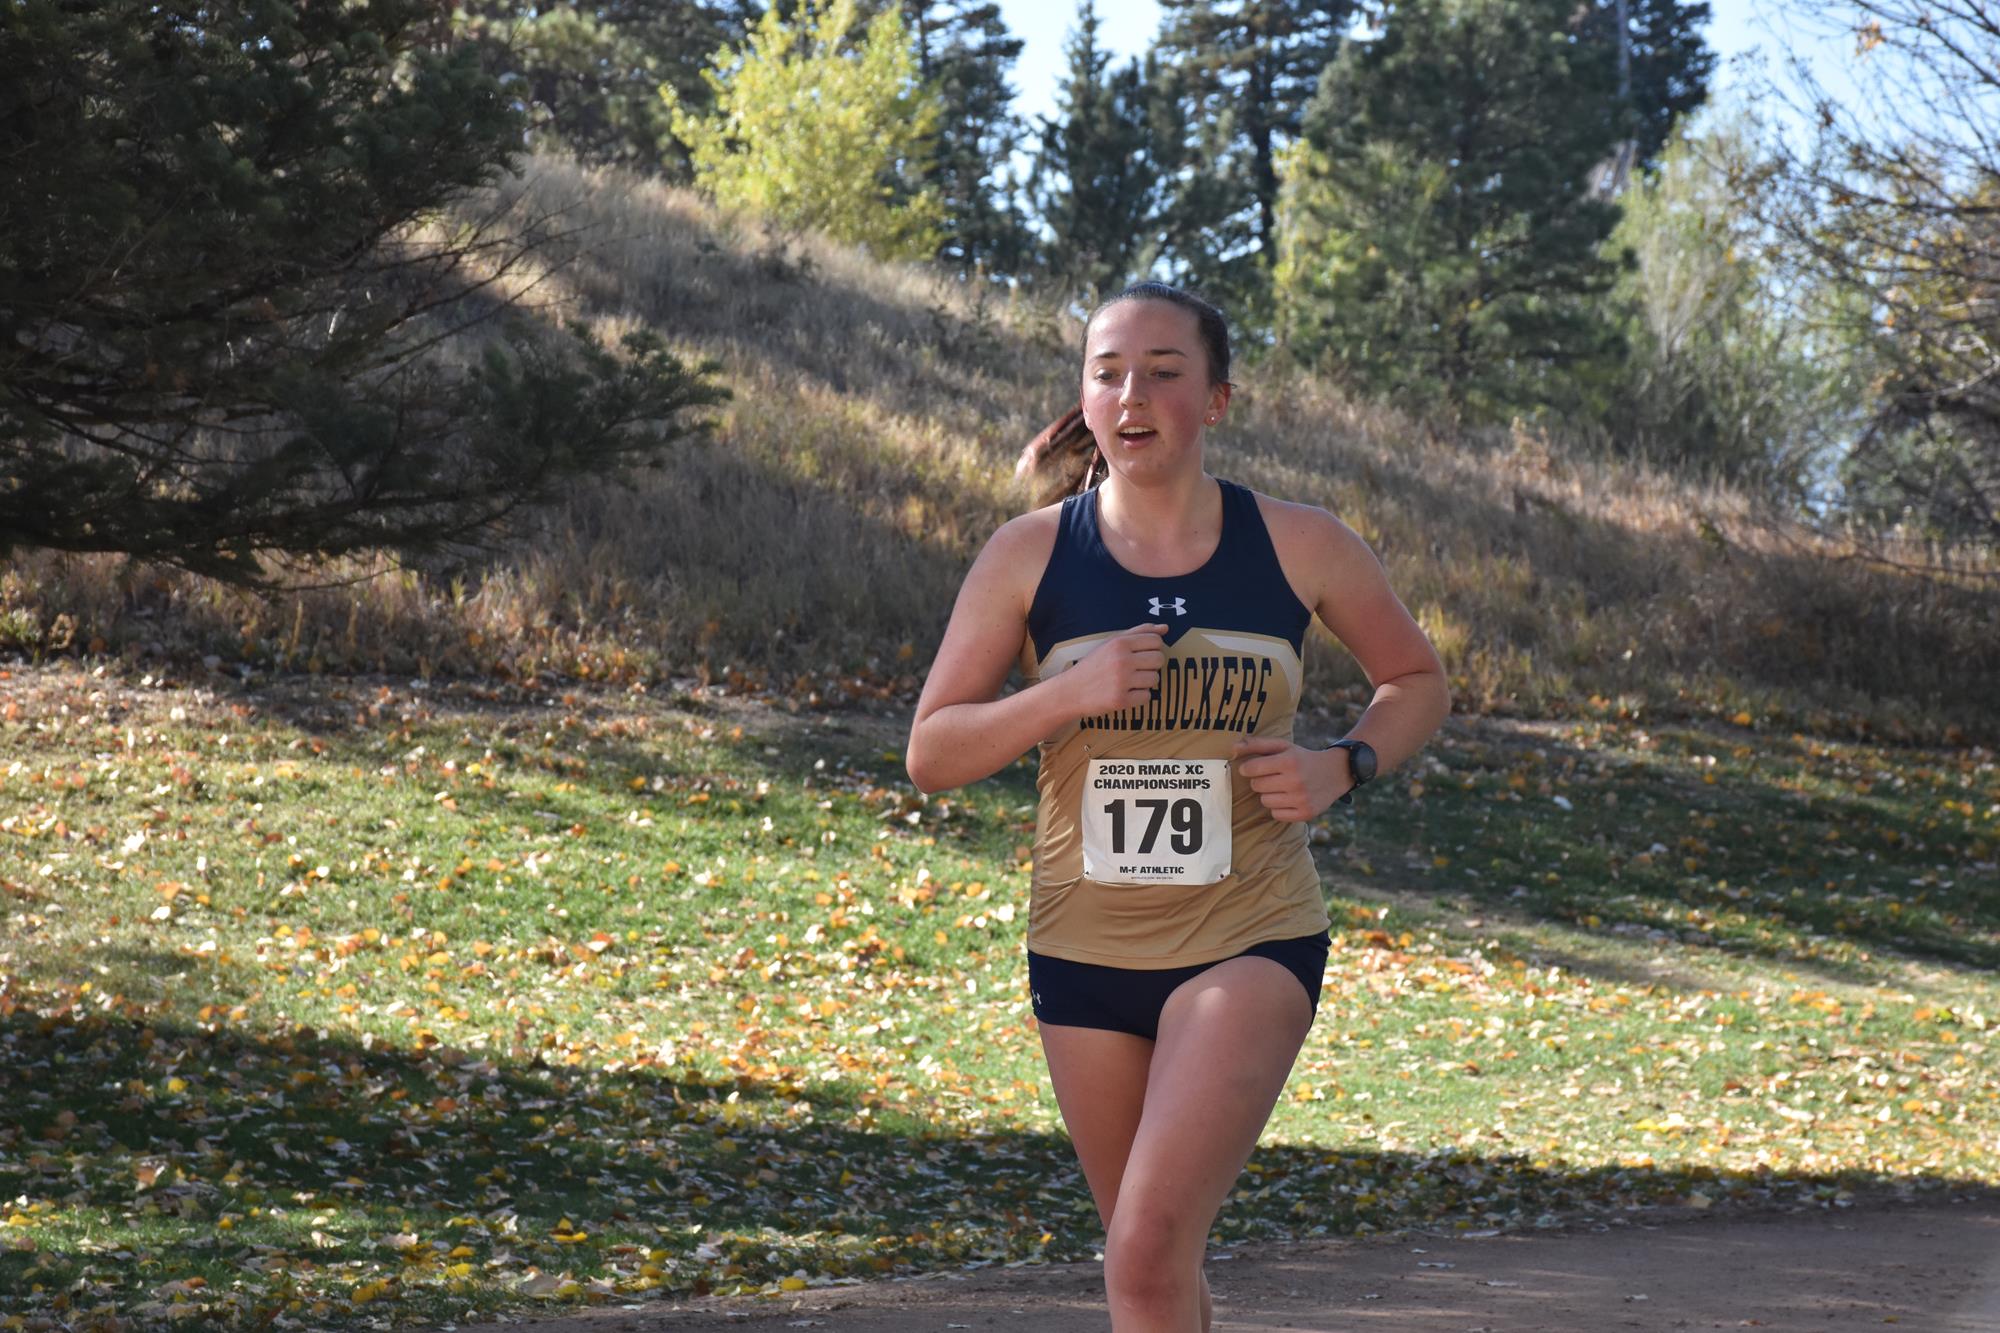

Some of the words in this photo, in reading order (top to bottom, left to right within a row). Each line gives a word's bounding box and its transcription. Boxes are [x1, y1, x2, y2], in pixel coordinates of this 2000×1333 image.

[1099, 764, 1135, 776] 2020
[1138, 764, 1181, 776] RMAC
[1184, 764, 1204, 775] XC
[1093, 778, 1211, 790] CHAMPIONSHIPS
[1104, 798, 1203, 855] 179
[1119, 866, 1137, 874] M-F
[1139, 866, 1185, 874] ATHLETIC
